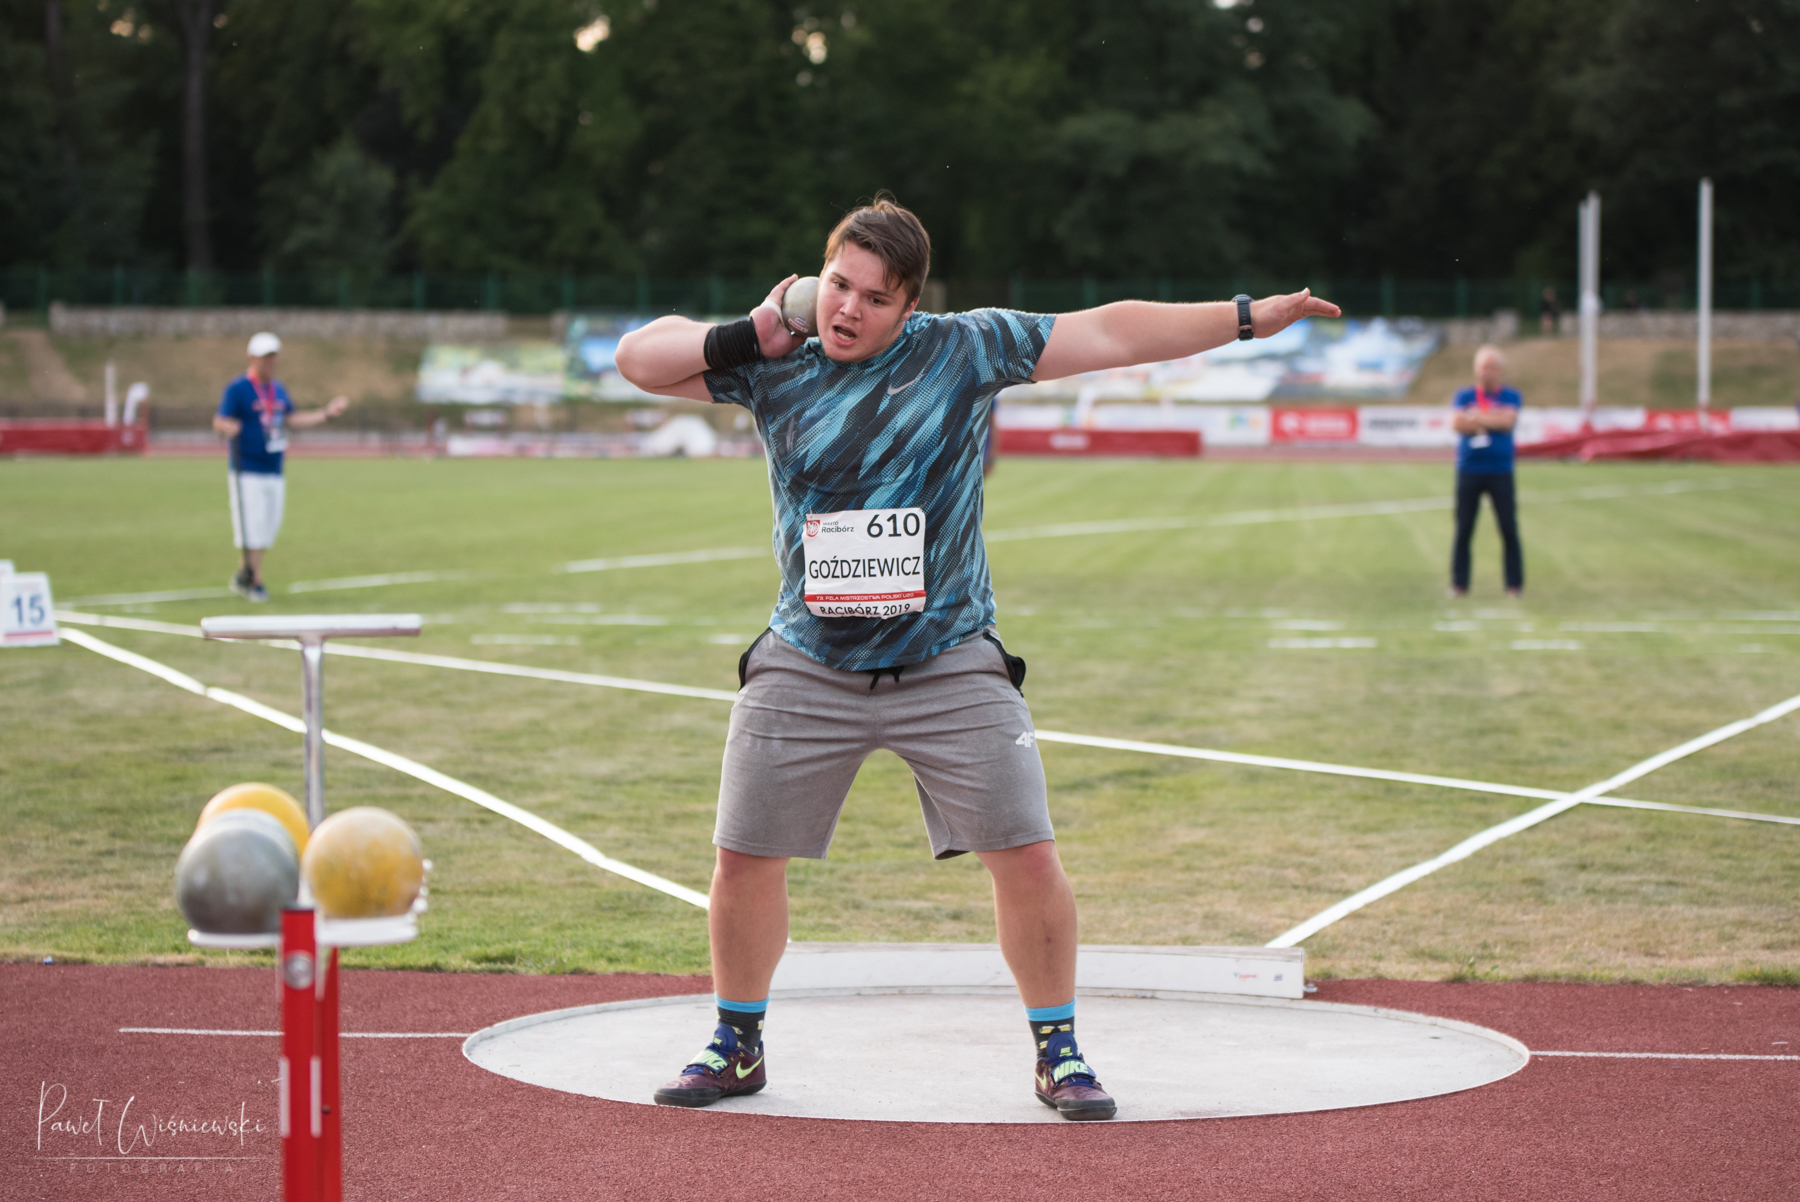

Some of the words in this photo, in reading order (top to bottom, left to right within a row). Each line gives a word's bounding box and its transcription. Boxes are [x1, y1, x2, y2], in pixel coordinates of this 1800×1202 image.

[821, 525, 855, 533] Racibórz
[866, 512, 920, 538] 610
[808, 555, 921, 579] GOŹDZIEWICZ
[11, 594, 46, 626] 15
[819, 603, 880, 616] RACIBÓRZ
[882, 603, 911, 616] 2019
[1054, 1060, 1089, 1083] NIKE
